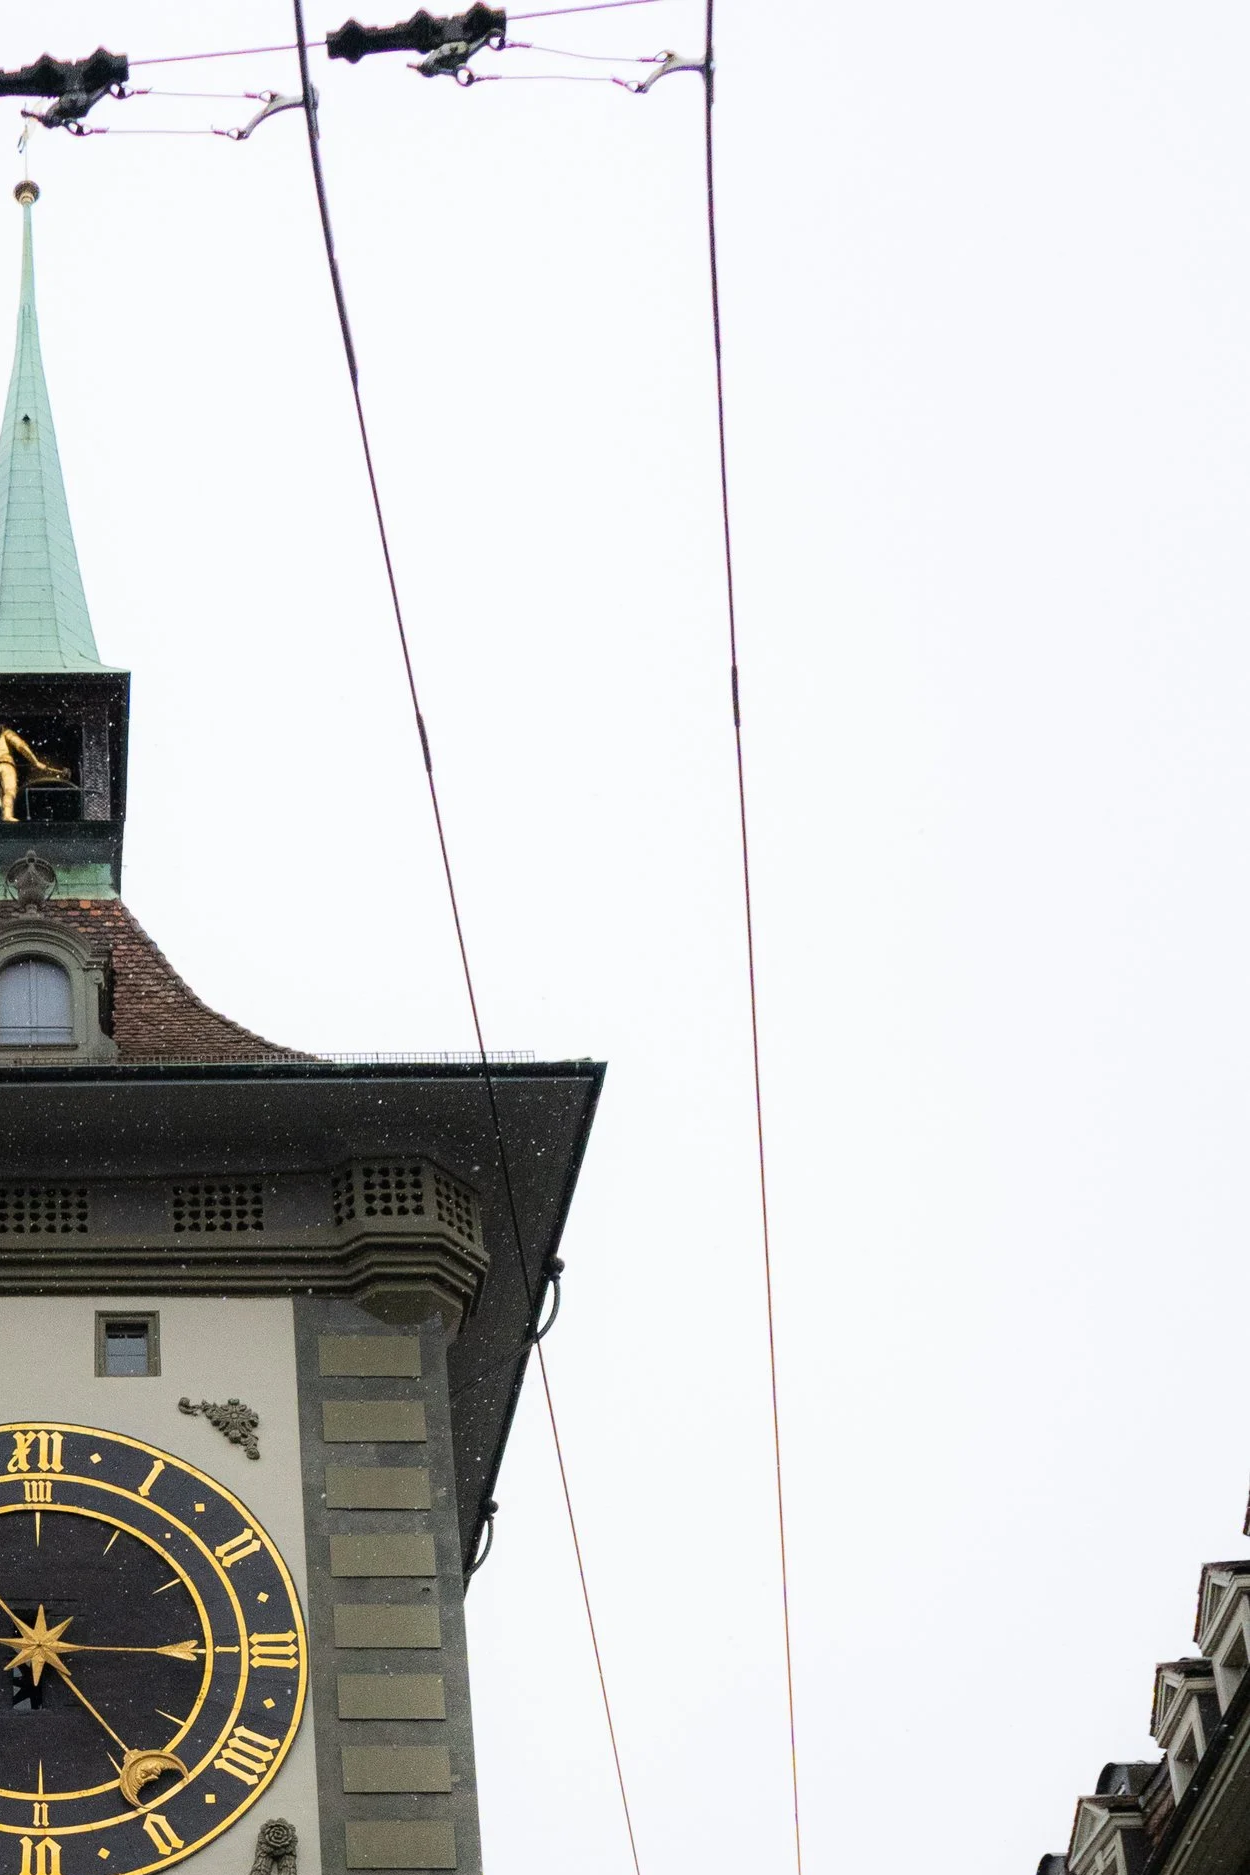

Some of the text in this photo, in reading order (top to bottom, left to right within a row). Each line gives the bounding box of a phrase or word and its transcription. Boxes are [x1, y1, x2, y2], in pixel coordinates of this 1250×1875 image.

[7, 1431, 64, 1473] XII
[24, 1481, 52, 1502] IIII
[138, 1460, 164, 1496] I
[215, 1528, 261, 1568] II
[215, 1645, 239, 1654] I
[250, 1631, 297, 1669] III
[215, 1726, 280, 1785] IIII
[33, 1802, 49, 1826] II
